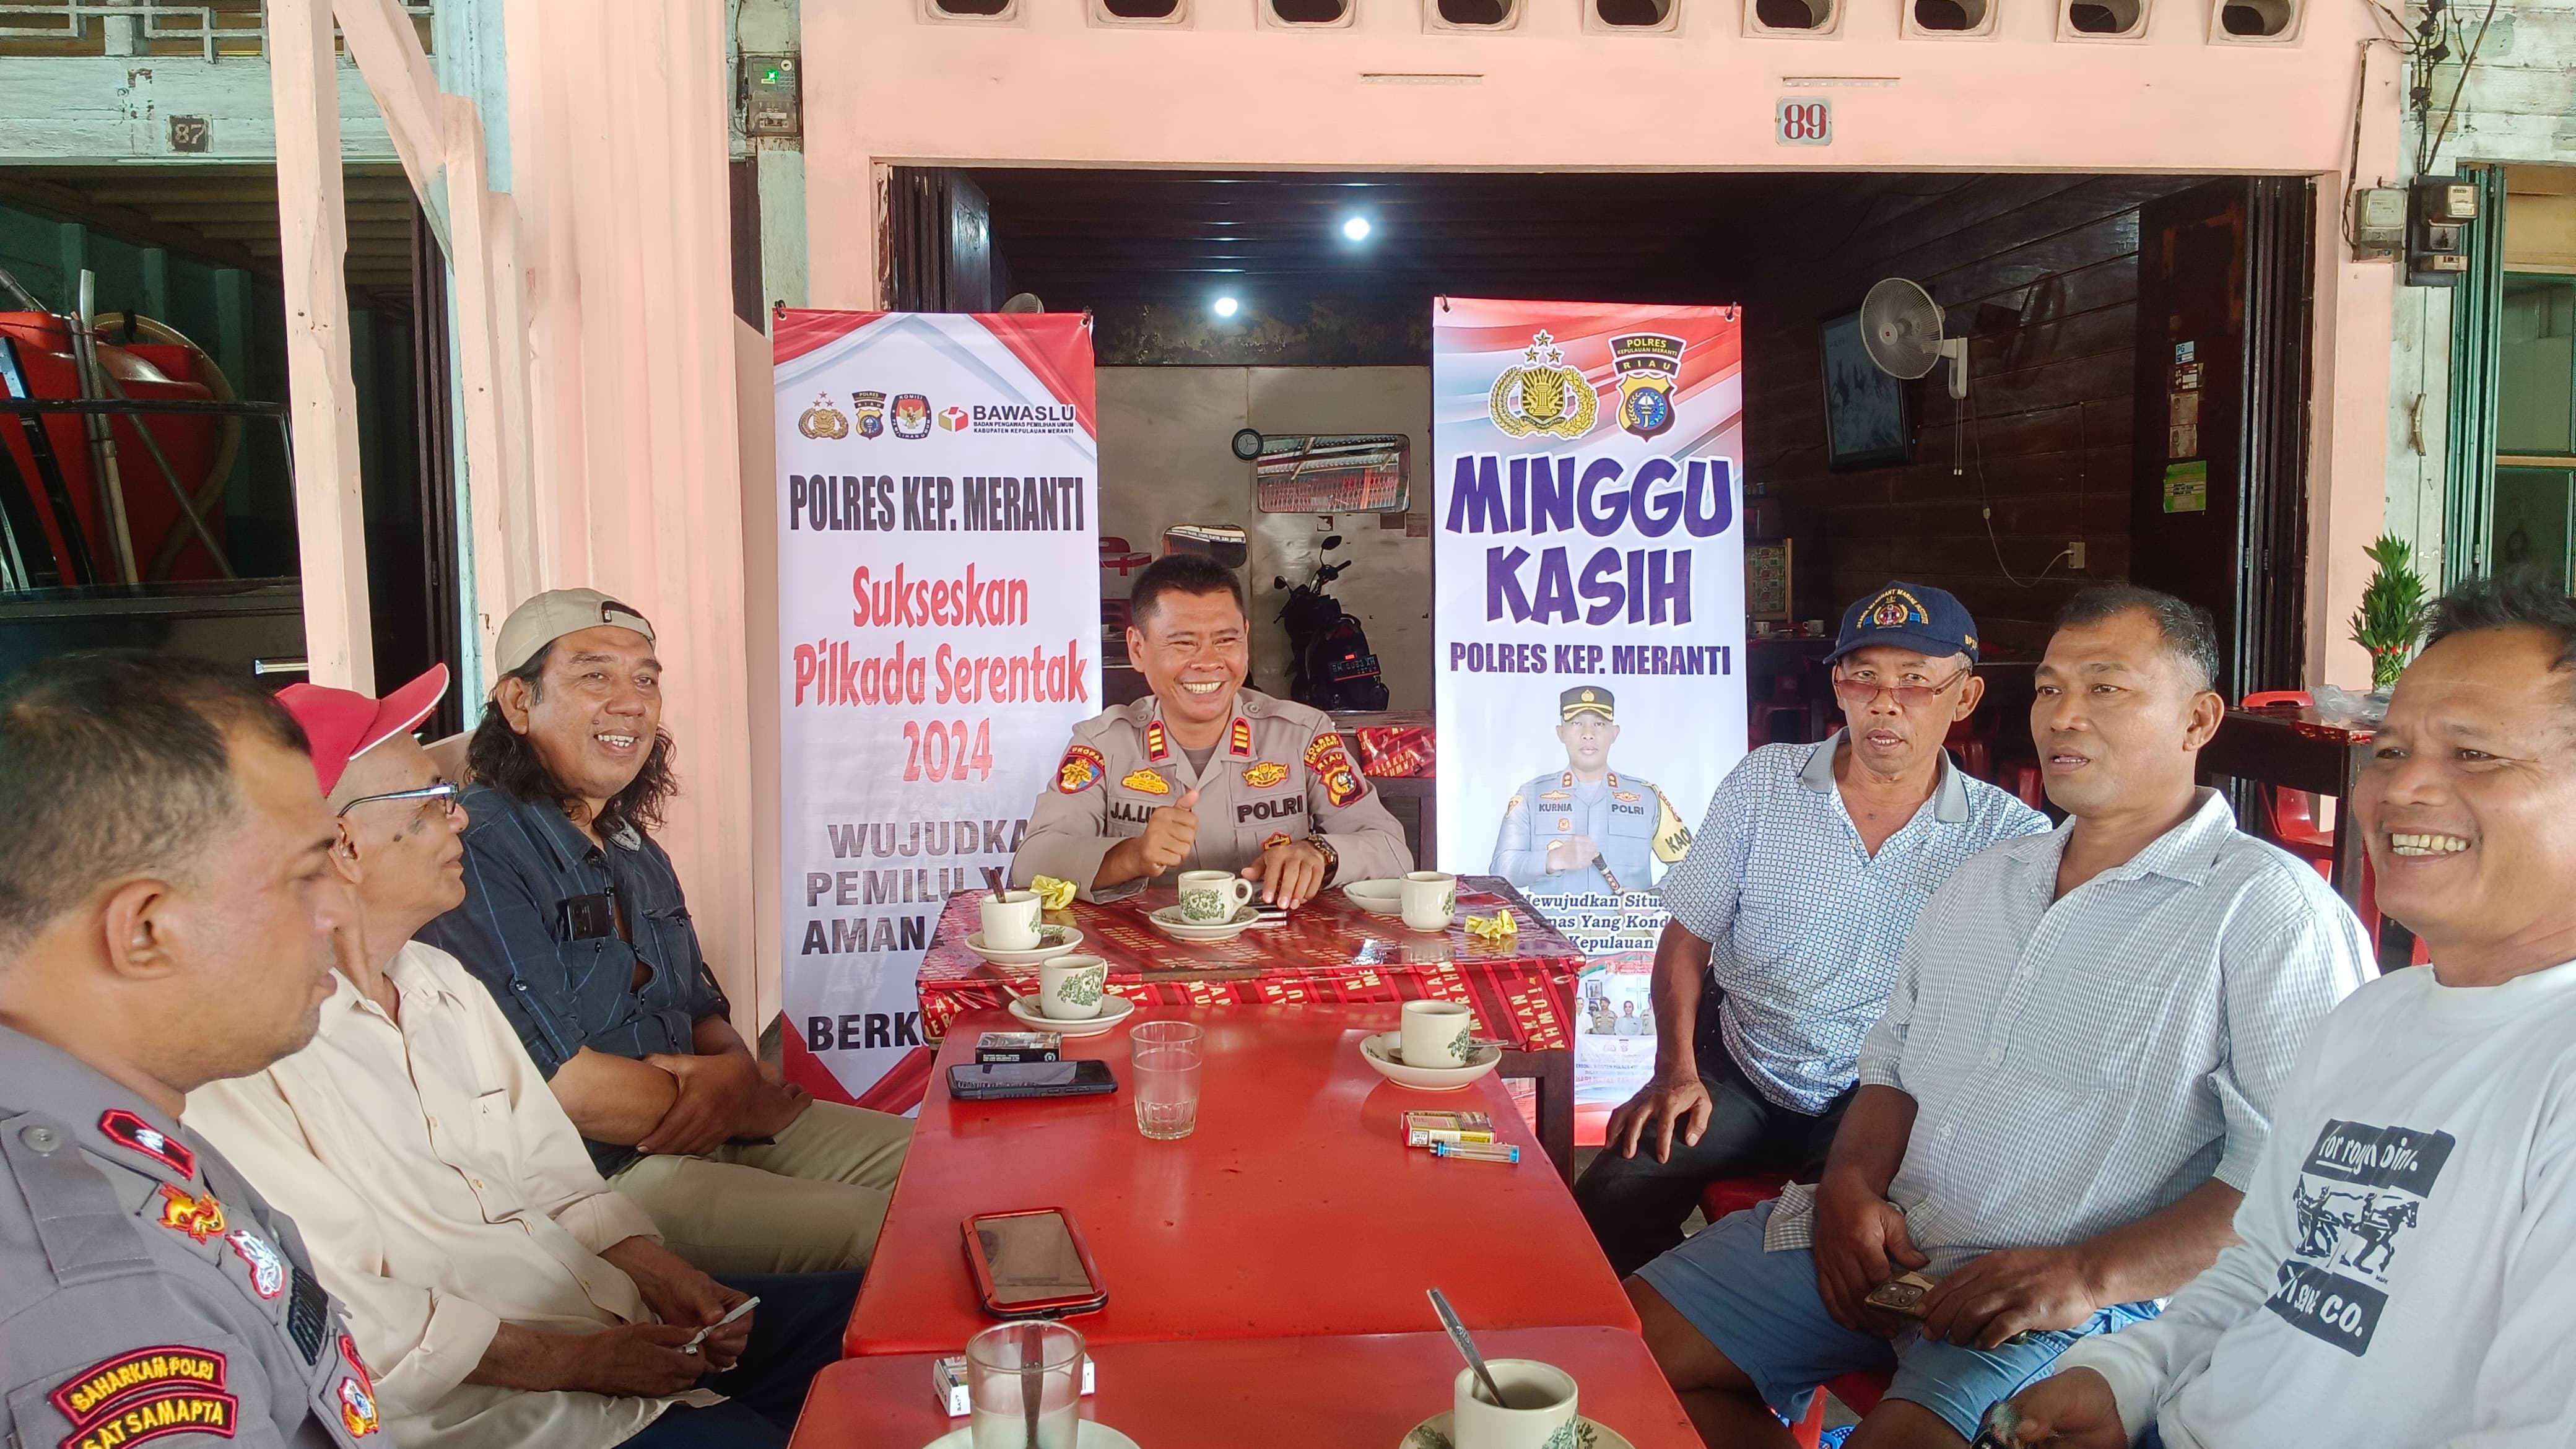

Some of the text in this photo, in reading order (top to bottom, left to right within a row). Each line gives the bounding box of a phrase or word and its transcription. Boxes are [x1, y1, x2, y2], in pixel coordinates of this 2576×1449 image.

[175, 123, 205, 144] 87
[1784, 103, 1827, 139] 89
[1626, 338, 1667, 348] POLRES
[1651, 347, 1677, 357] MERANTI
[1622, 360, 1671, 370] RIAU
[973, 405, 1074, 421] BAWASLU
[790, 474, 1084, 531] POLRES KEP. MERANTI
[1446, 455, 1733, 537] MINGGU
[853, 562, 1029, 628] Sukseskan
[1486, 546, 1692, 626] KASIH
[793, 638, 1088, 707] Pilkada Serentak
[1450, 642, 1731, 676] POLRES KEP. MERANTI
[903, 718, 993, 783] 2024
[1305, 735, 1338, 762] POLRES
[1317, 754, 1342, 770] RIAU
[1238, 796, 1304, 823] POLRI
[1539, 803, 1645, 816] KURNIA POLRI
[827, 819, 1029, 858] WUJUDKA
[1664, 829, 1692, 855] KAO
[801, 916, 925, 955] AMAN
[1582, 915, 1621, 931] Yang
[1625, 915, 1669, 928] Kond
[807, 1011, 920, 1051] BERK
[2320, 1295, 2363, 1338] CO.
[169, 1357, 214, 1380] POLRI
[125, 1399, 224, 1434] SAMAPTA
